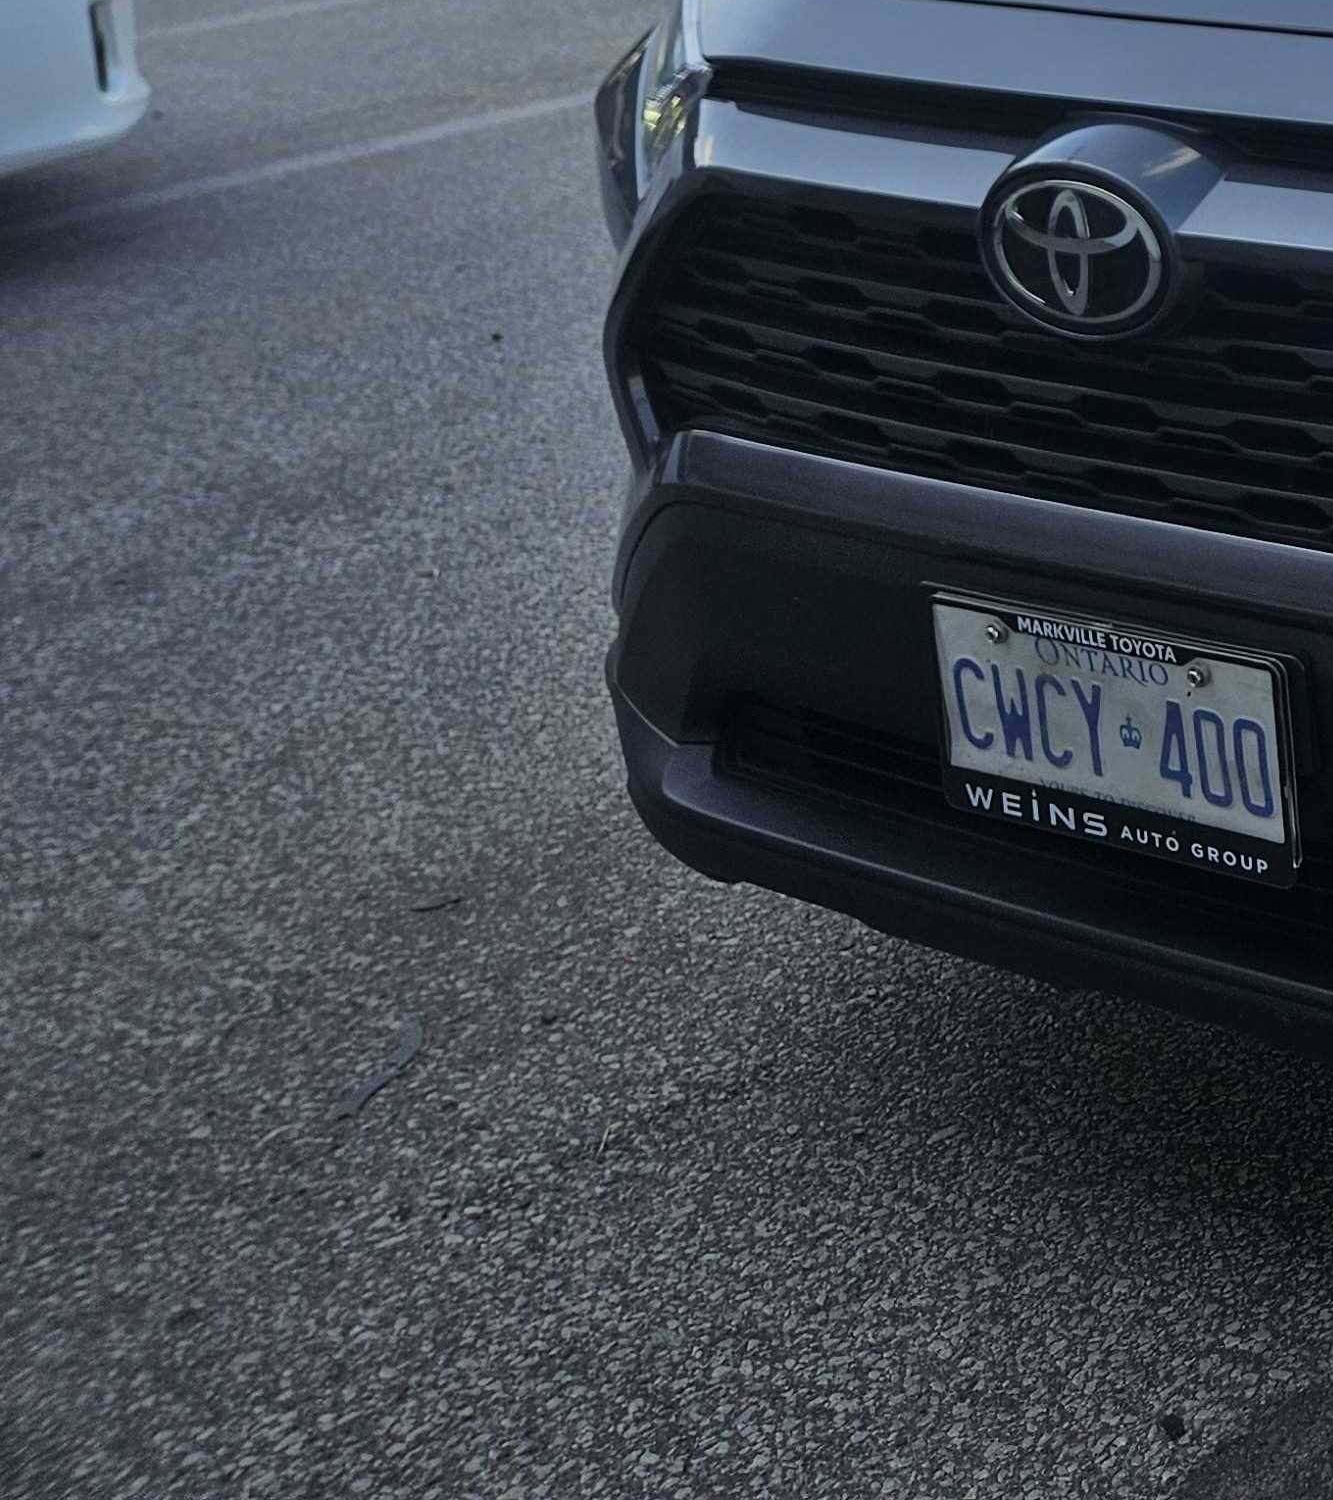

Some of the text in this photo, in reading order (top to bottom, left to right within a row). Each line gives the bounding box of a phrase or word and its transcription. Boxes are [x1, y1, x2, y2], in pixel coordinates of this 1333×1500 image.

[1016, 615, 1177, 664] MARKVILLE TOYOTA
[1034, 635, 1169, 687] ONTARIO
[953, 657, 1274, 818] CWCY 400
[1120, 825, 1179, 852] AUTO
[1190, 842, 1268, 874] GROUP
